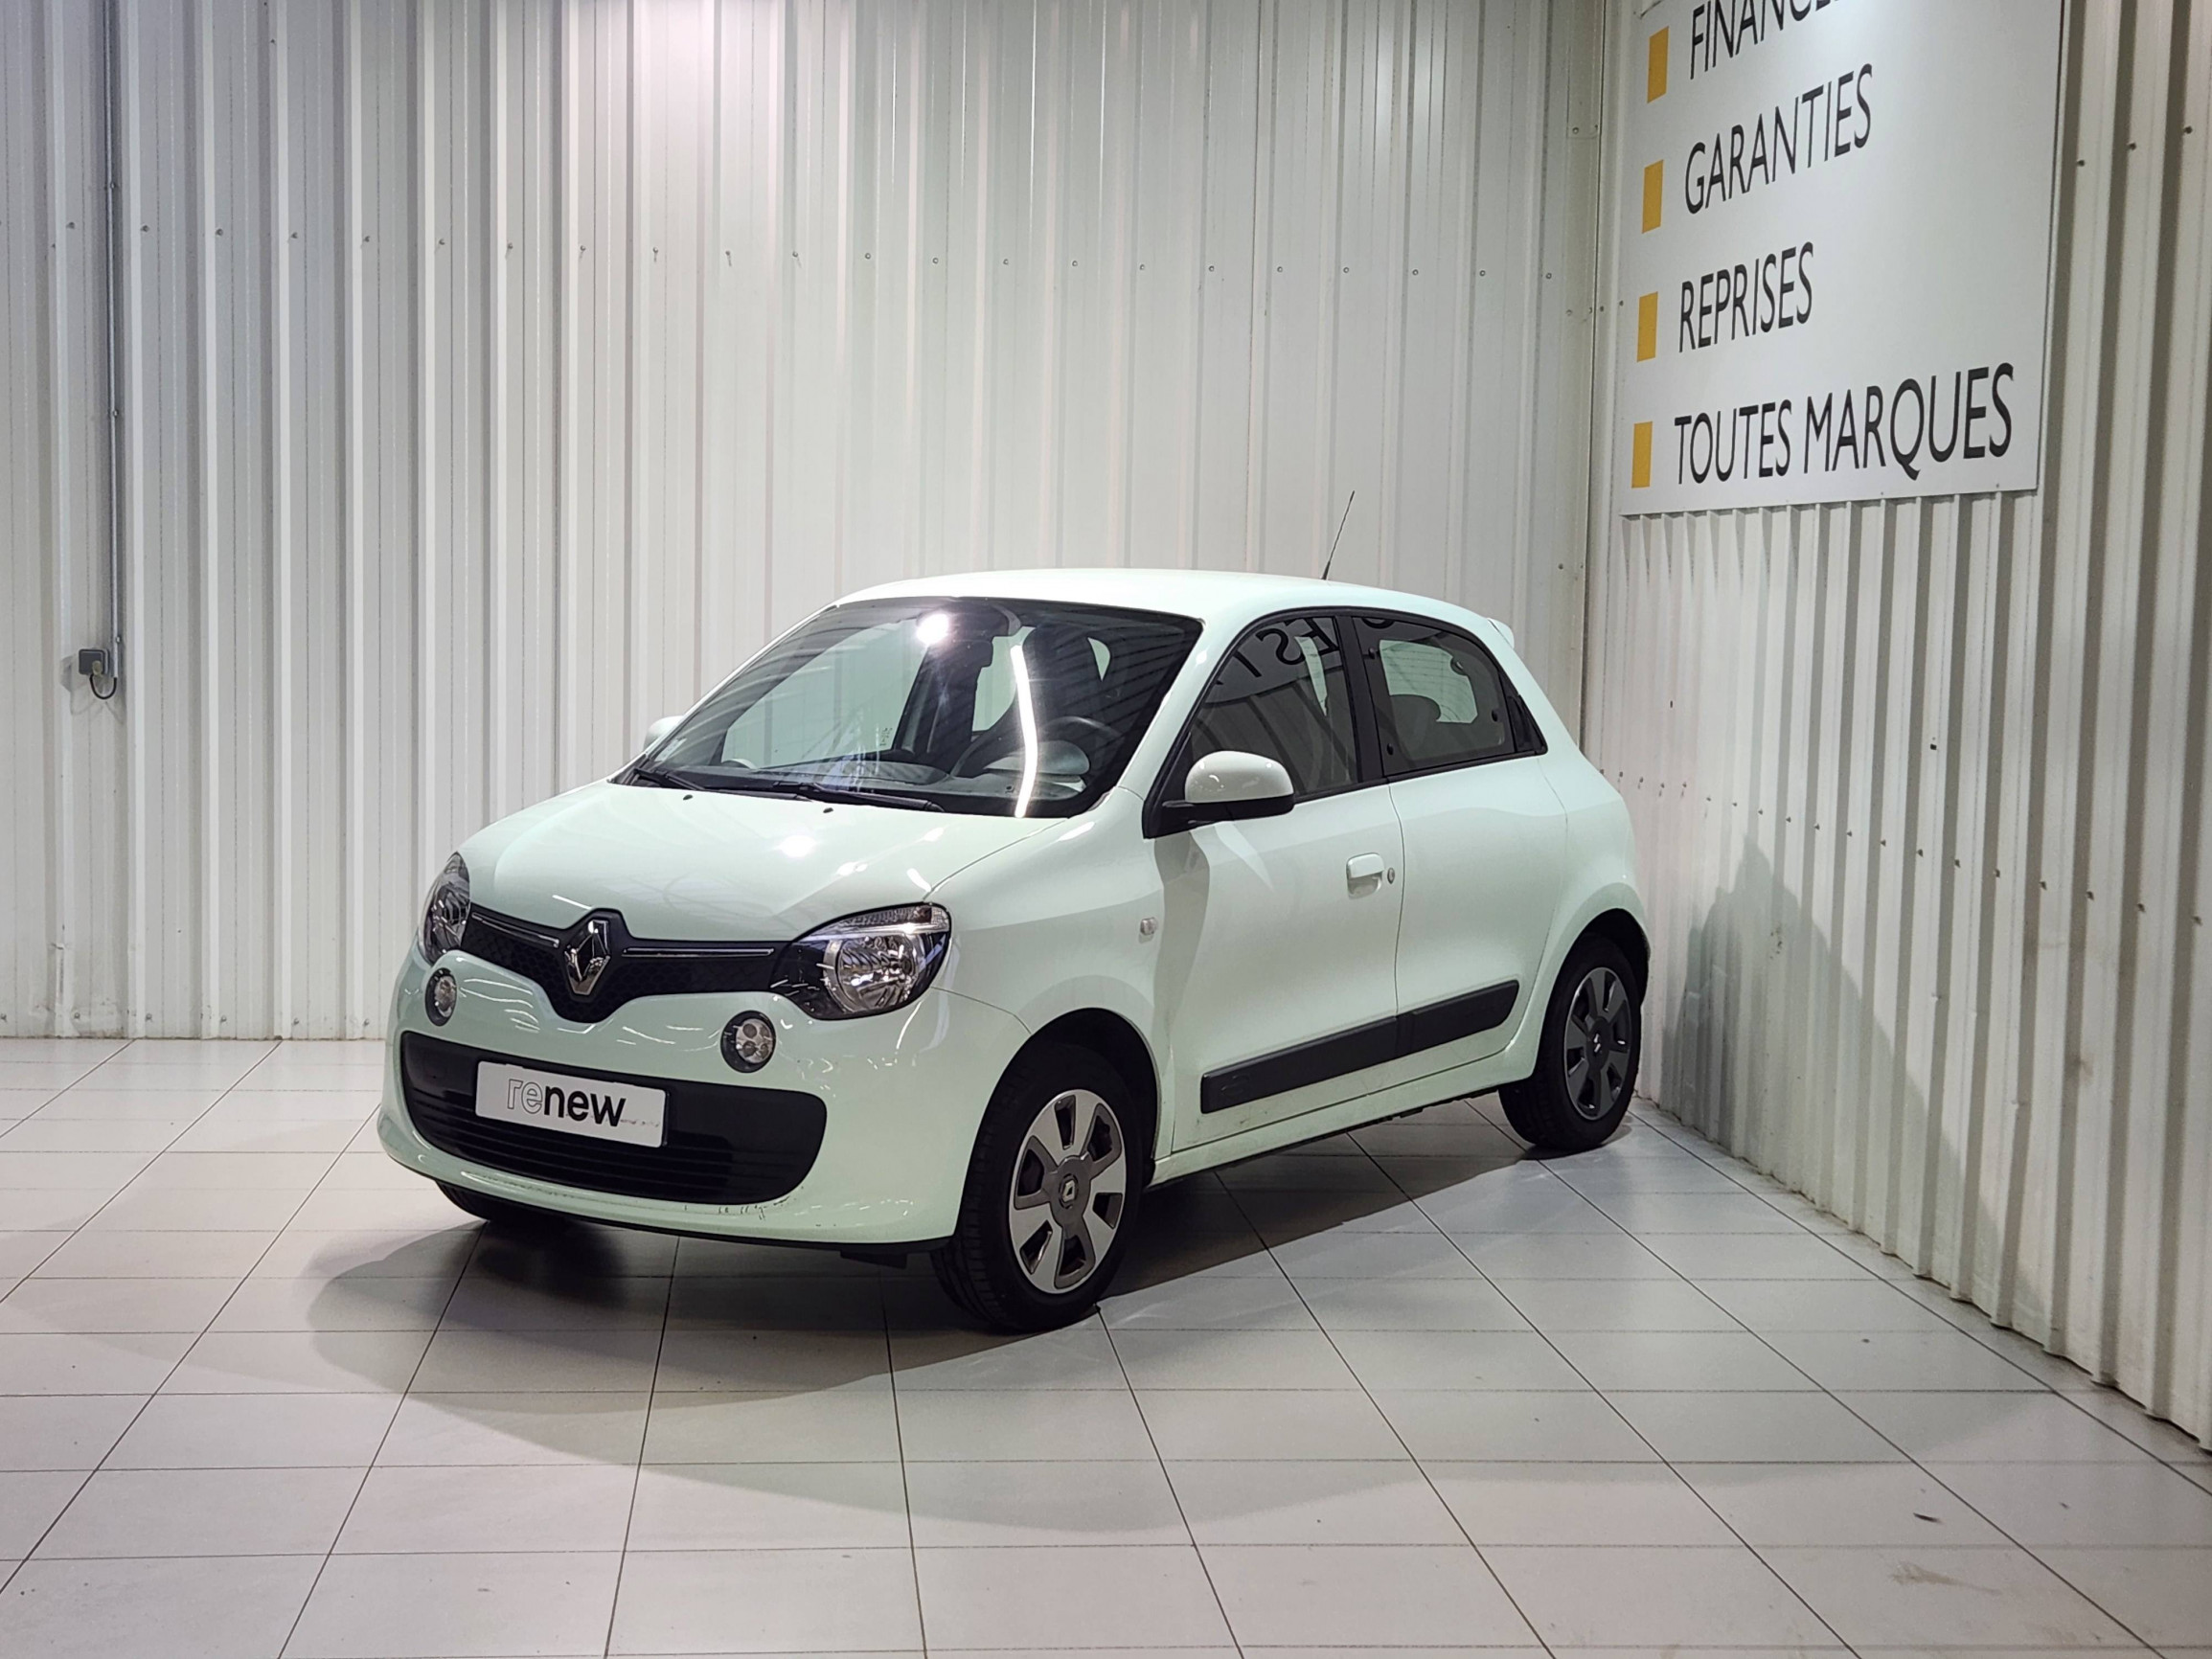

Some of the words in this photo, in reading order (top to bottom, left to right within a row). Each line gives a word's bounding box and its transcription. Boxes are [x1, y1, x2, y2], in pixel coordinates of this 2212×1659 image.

[1684, 63, 1873, 215] GARANTIES
[1678, 241, 1813, 353] REPRISES
[1674, 398, 1792, 485] TOUTES
[1803, 362, 2015, 481] MARQUES
[507, 1079, 627, 1127] renew
